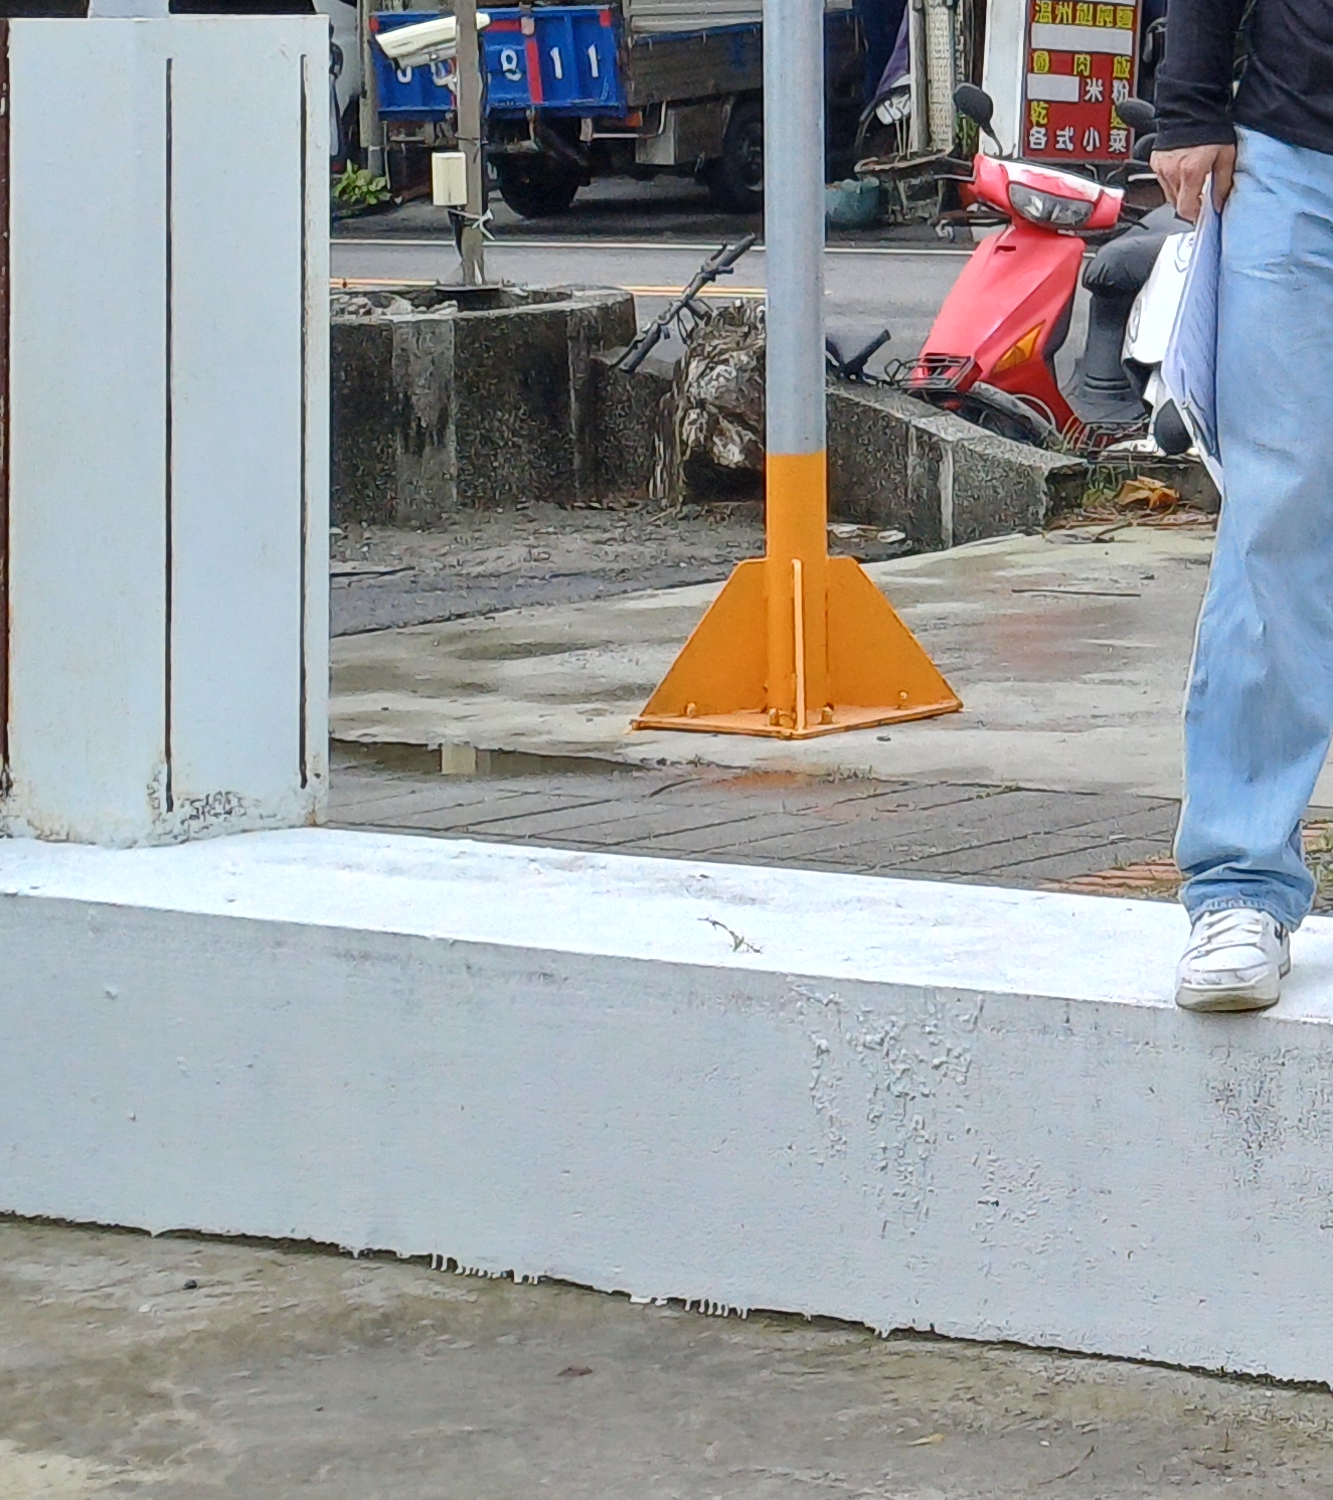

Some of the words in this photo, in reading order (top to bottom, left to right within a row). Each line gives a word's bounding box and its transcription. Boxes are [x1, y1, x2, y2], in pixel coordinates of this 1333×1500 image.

[1083, 77, 1129, 105] 米粉
[1028, 126, 1129, 153] 各式小菜
